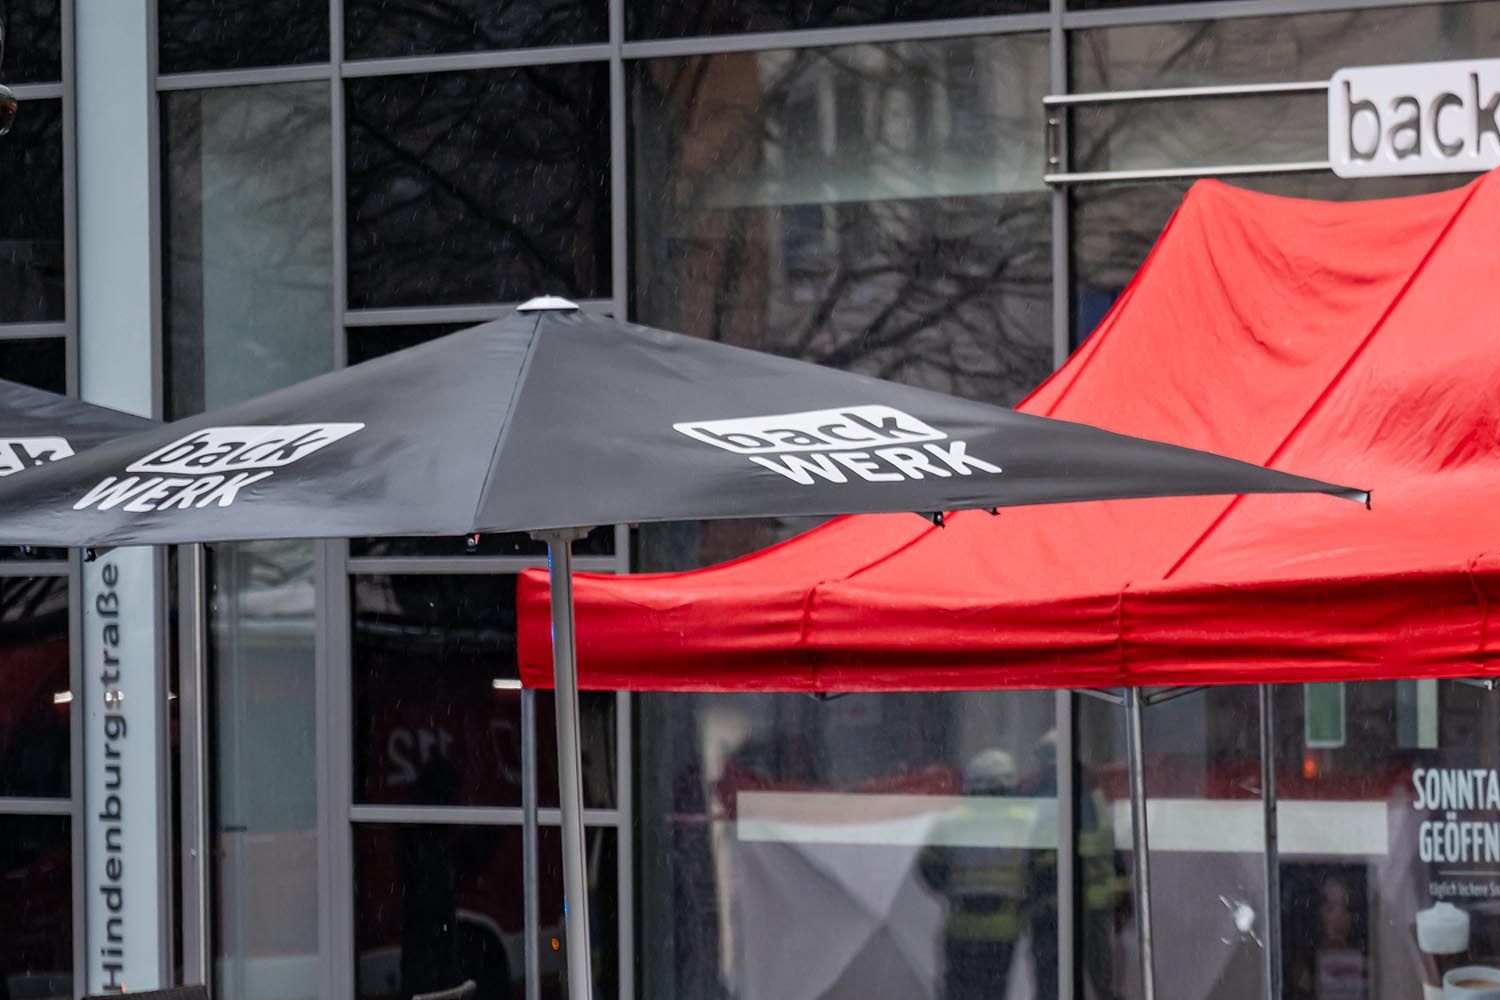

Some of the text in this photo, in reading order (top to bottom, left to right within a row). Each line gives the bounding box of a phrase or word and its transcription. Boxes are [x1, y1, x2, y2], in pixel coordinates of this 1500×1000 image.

[141, 427, 330, 469] back
[692, 412, 932, 449] back
[748, 440, 1003, 485] WERK
[72, 470, 275, 513] WERK
[96, 563, 128, 992] Hindenburgstraße
